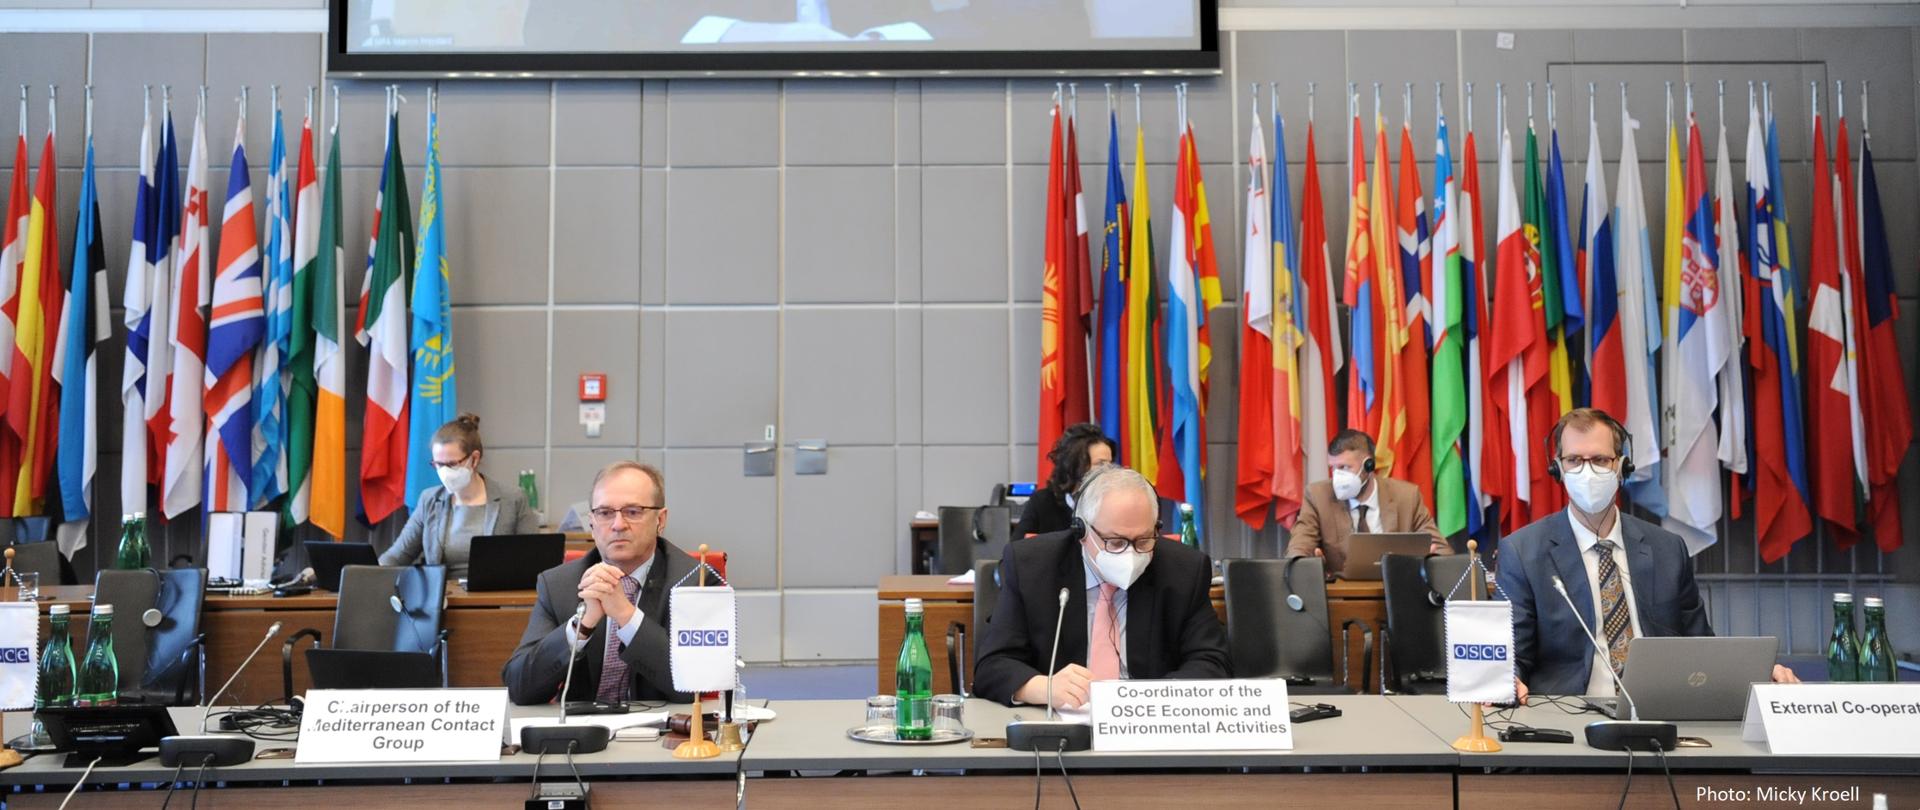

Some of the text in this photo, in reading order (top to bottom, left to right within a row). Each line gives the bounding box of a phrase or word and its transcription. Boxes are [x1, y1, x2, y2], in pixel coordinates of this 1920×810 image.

[0, 648, 29, 663] ce
[1117, 685, 1263, 698] Co-ordinator of the
[327, 700, 481, 716] Cairperson of the
[1111, 704, 1271, 718] OSCE Economic and
[1770, 700, 1838, 714] External
[431, 718, 495, 731] Contact
[1098, 721, 1287, 735] Environmental Activities
[373, 736, 424, 752] Group
